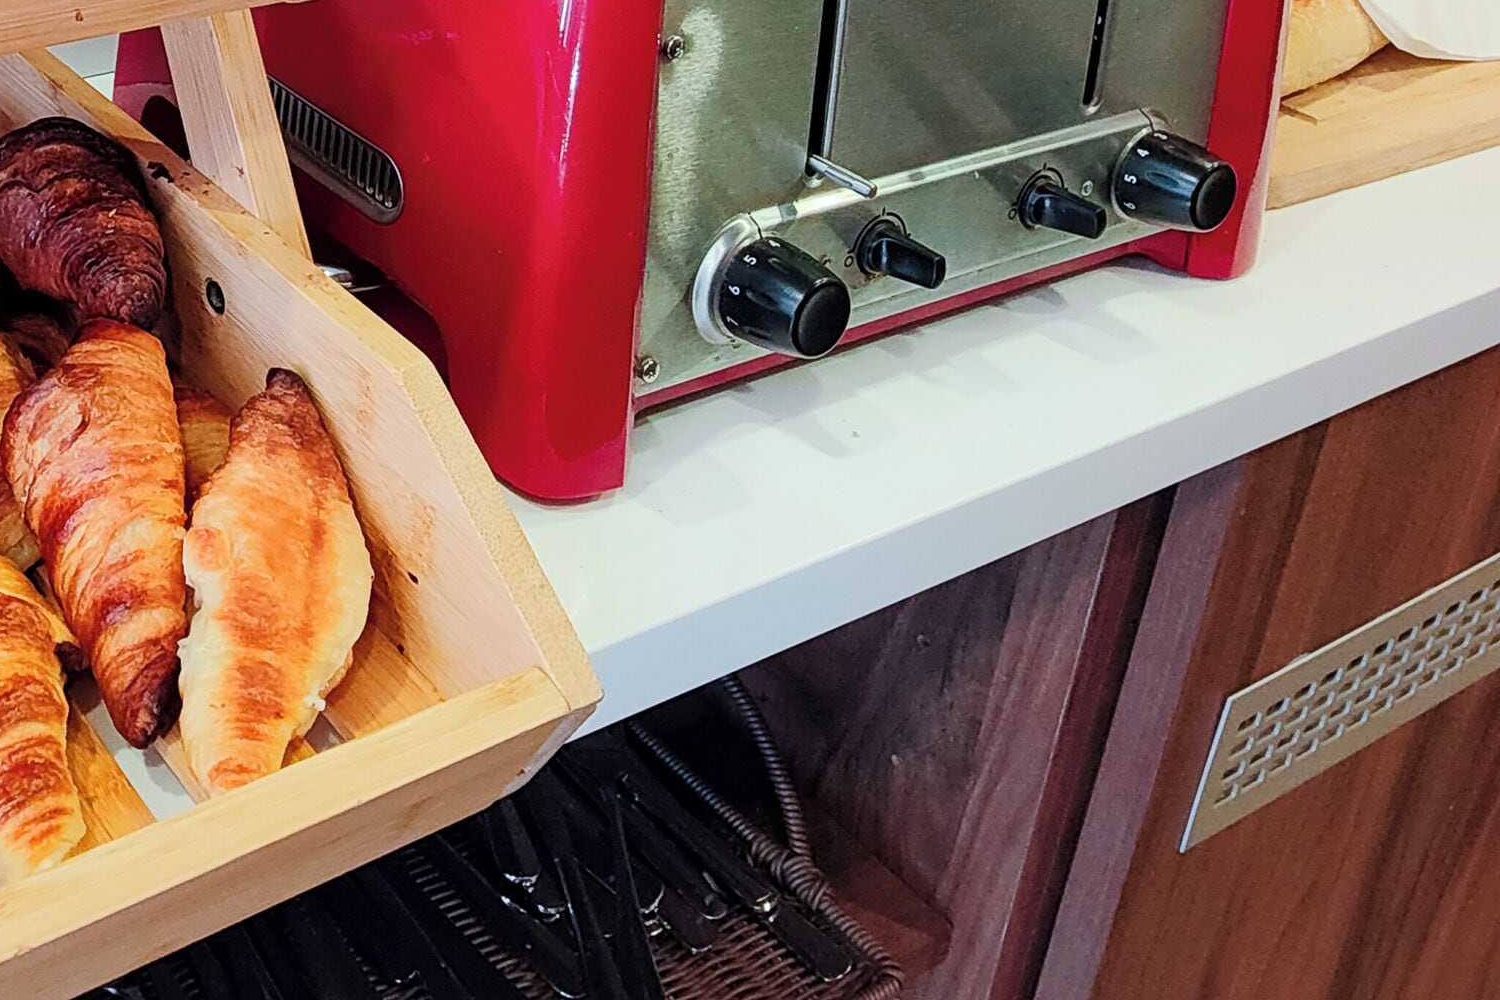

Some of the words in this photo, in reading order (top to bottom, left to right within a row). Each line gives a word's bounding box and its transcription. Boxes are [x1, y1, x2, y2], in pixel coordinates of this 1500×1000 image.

[1136, 148, 1150, 157] 4
[1124, 174, 1137, 185] 5
[1123, 201, 1136, 210] 6
[743, 254, 757, 266] 5
[728, 285, 741, 296] 6
